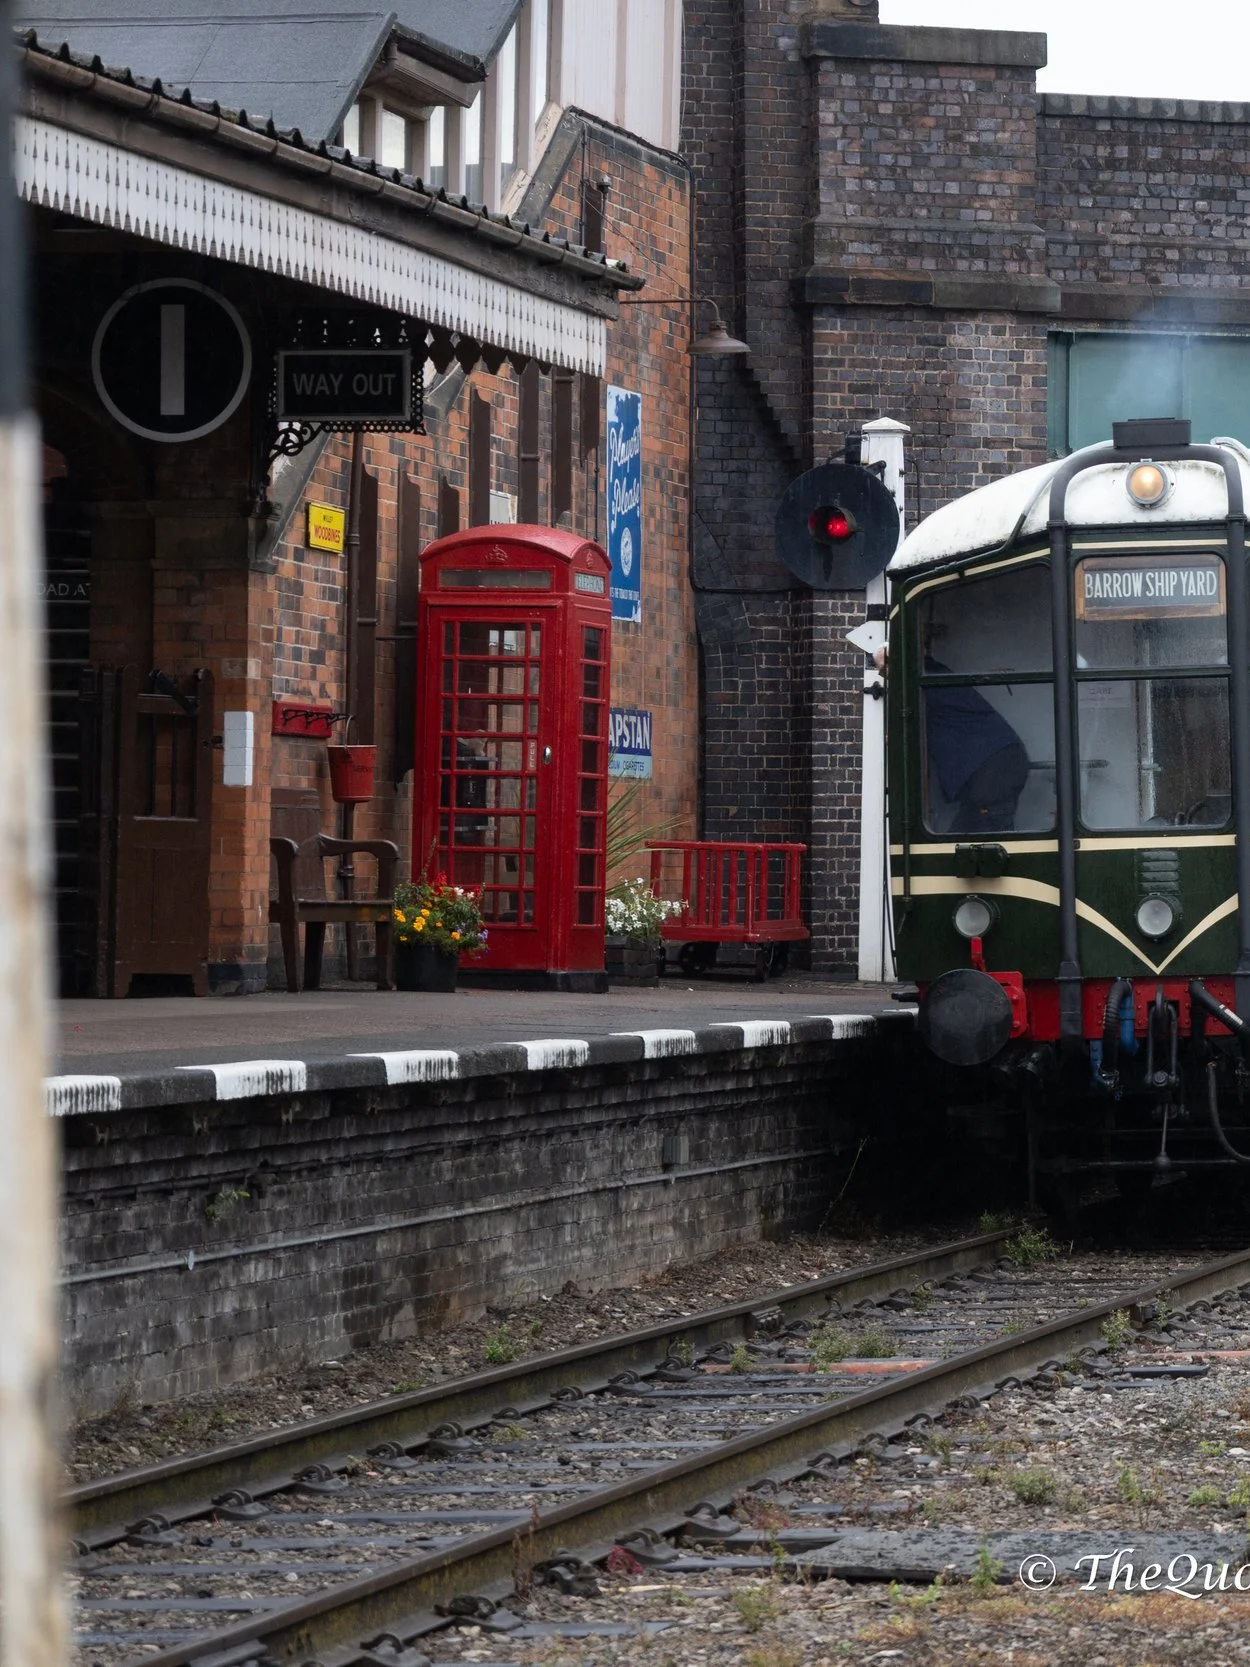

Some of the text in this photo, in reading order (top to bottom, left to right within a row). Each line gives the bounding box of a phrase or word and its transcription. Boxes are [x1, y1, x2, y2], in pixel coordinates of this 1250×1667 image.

[292, 372, 397, 396] WAY OUT
[1085, 570, 1218, 599] BARROW SHIP YARD
[609, 713, 651, 750] APSTAN
